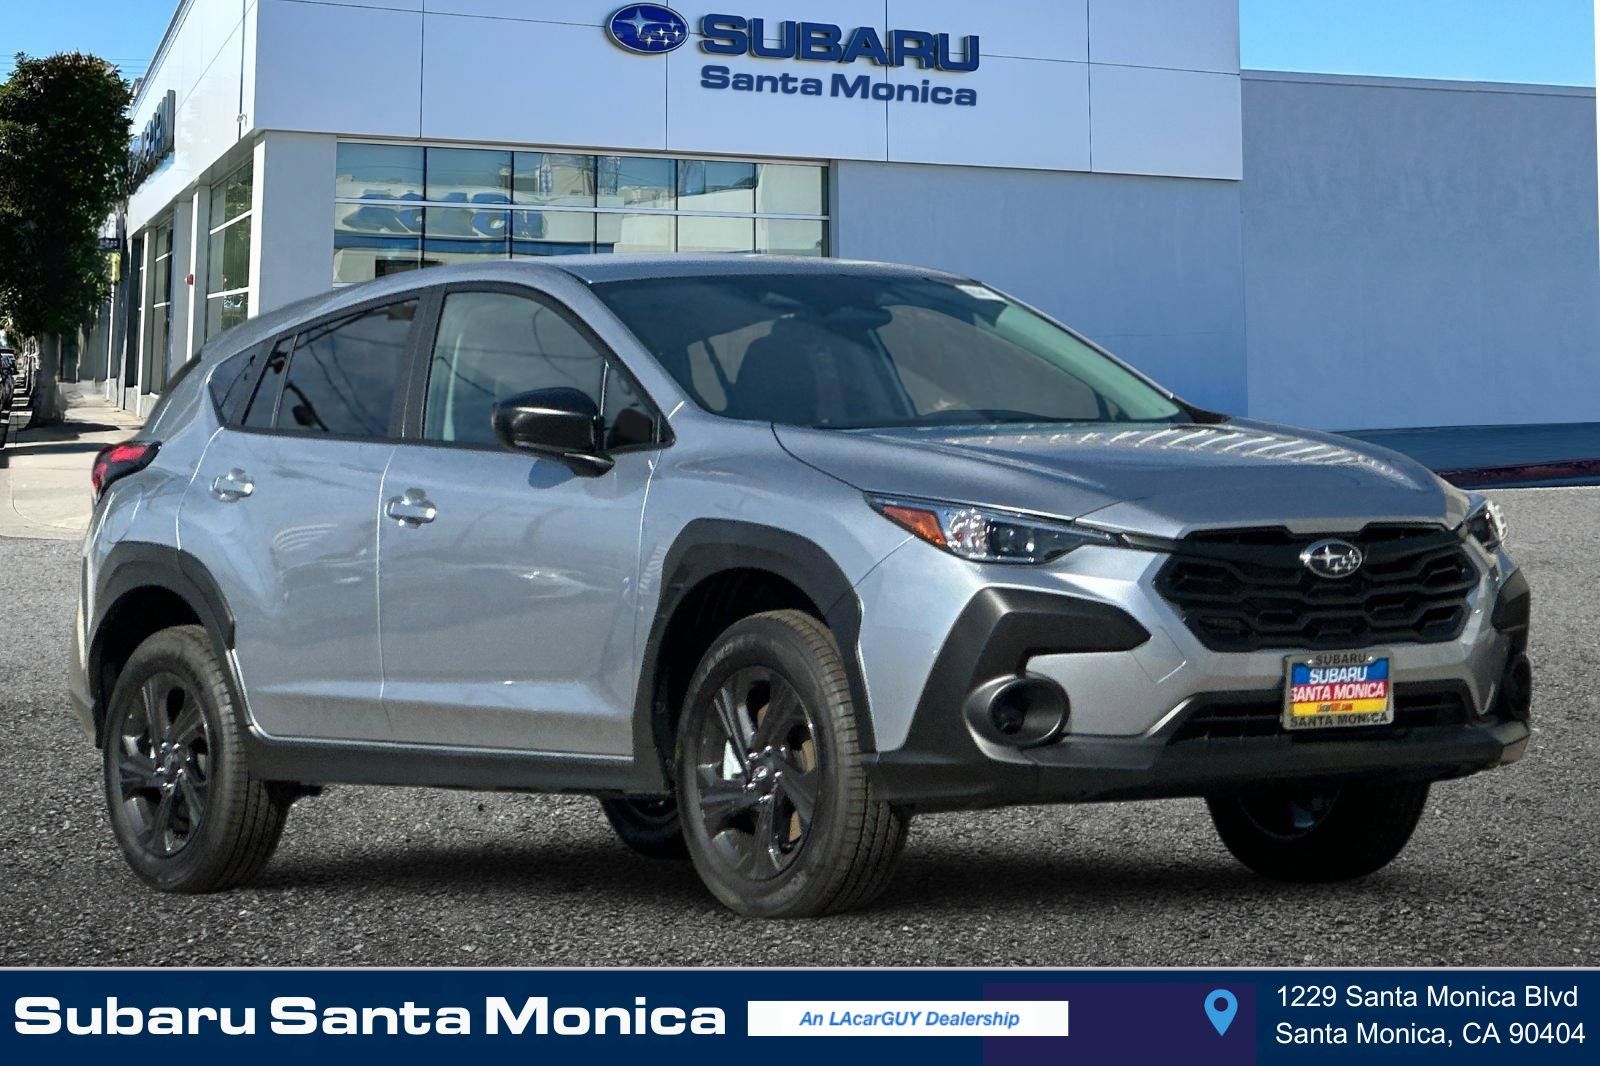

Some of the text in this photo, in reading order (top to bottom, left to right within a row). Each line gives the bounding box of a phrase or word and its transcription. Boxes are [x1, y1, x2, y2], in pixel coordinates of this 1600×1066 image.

[699, 13, 980, 72] SUBARU
[700, 64, 978, 107] Santa Monica
[1315, 653, 1366, 665] SUBARU
[1309, 666, 1367, 684] SUBARU
[1334, 682, 1385, 699] MONICA
